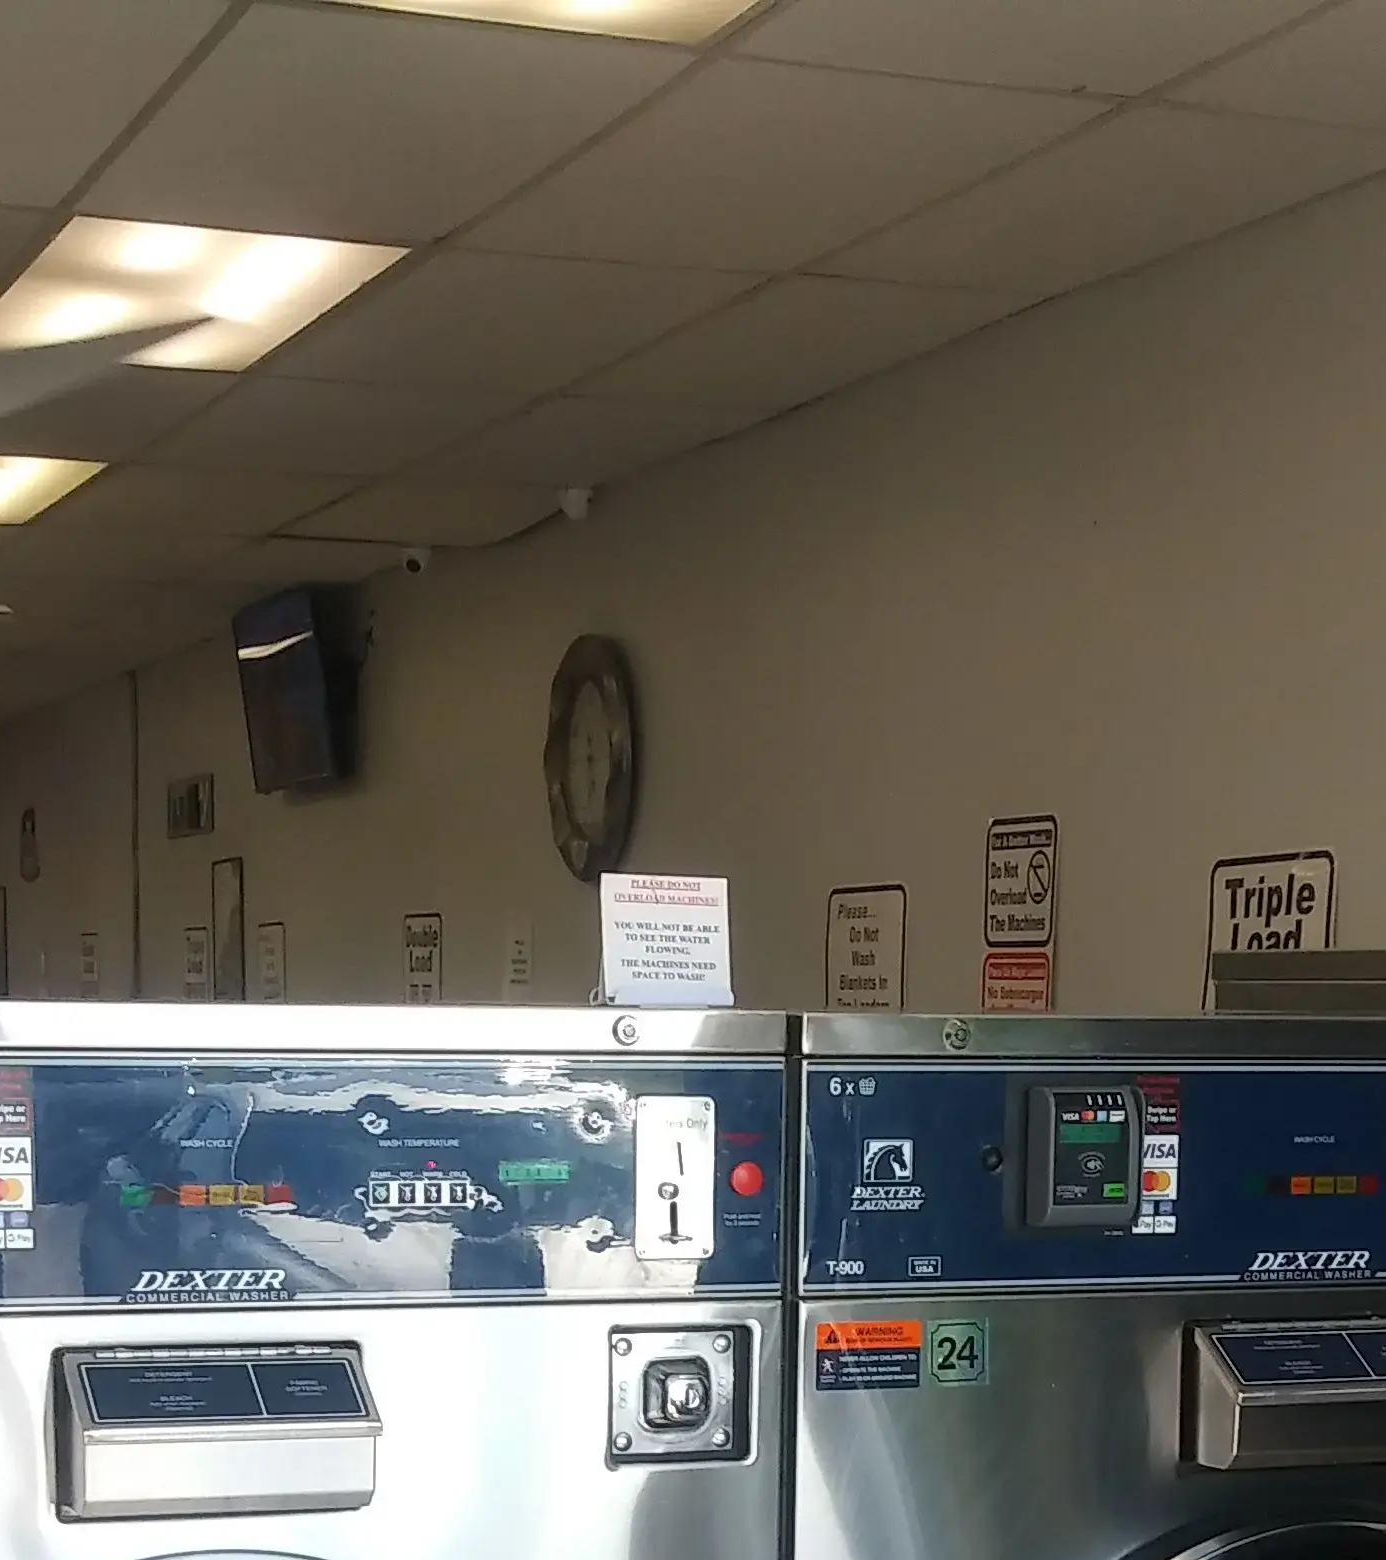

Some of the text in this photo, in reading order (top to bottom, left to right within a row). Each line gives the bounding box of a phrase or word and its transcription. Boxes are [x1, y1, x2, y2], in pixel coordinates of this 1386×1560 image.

[989, 861, 1019, 879] Do Not
[631, 879, 701, 891] PLEASE DO NOT
[614, 893, 665, 904] OVERLOAD
[990, 888, 1027, 905] Overload
[1224, 873, 1316, 928] Triple
[614, 920, 720, 933] YOU WILL NOT BE ABLE
[990, 913, 1046, 932] The Machines
[625, 933, 711, 945] TO SEE THE WATER
[849, 926, 879, 942] Do Not
[1230, 919, 1303, 950] Load
[851, 949, 876, 966] Wash
[621, 958, 717, 970] THE MACHINES NEED
[631, 971, 660, 980] SPACE
[663, 971, 676, 980] TO
[839, 973, 877, 990] Blankets
[829, 1077, 855, 1095] 6 x
[13, 1104, 27, 1113] or
[5, 1113, 27, 1124] Here
[1062, 1112, 1080, 1121] VISA
[1146, 1113, 1177, 1124] Tap Here
[686, 1117, 708, 1131] Only
[180, 1138, 234, 1148] WASH CYCLE
[378, 1138, 460, 1148] WASH TEMPERATURE
[851, 1186, 924, 1198] DEXTER
[850, 1199, 925, 1211] LAUNDRY
[1140, 1220, 1152, 1230] Pay
[1248, 1250, 1371, 1271] DEXTER
[826, 1260, 865, 1275] T-900
[915, 1265, 934, 1273] USA
[132, 1269, 288, 1292] DEXTER
[1243, 1270, 1372, 1281] COMMERCIAL WASHER
[126, 1291, 289, 1303] COMMERCIAL WASHER
[855, 1326, 904, 1337] WARNING
[937, 1336, 978, 1370] 24
